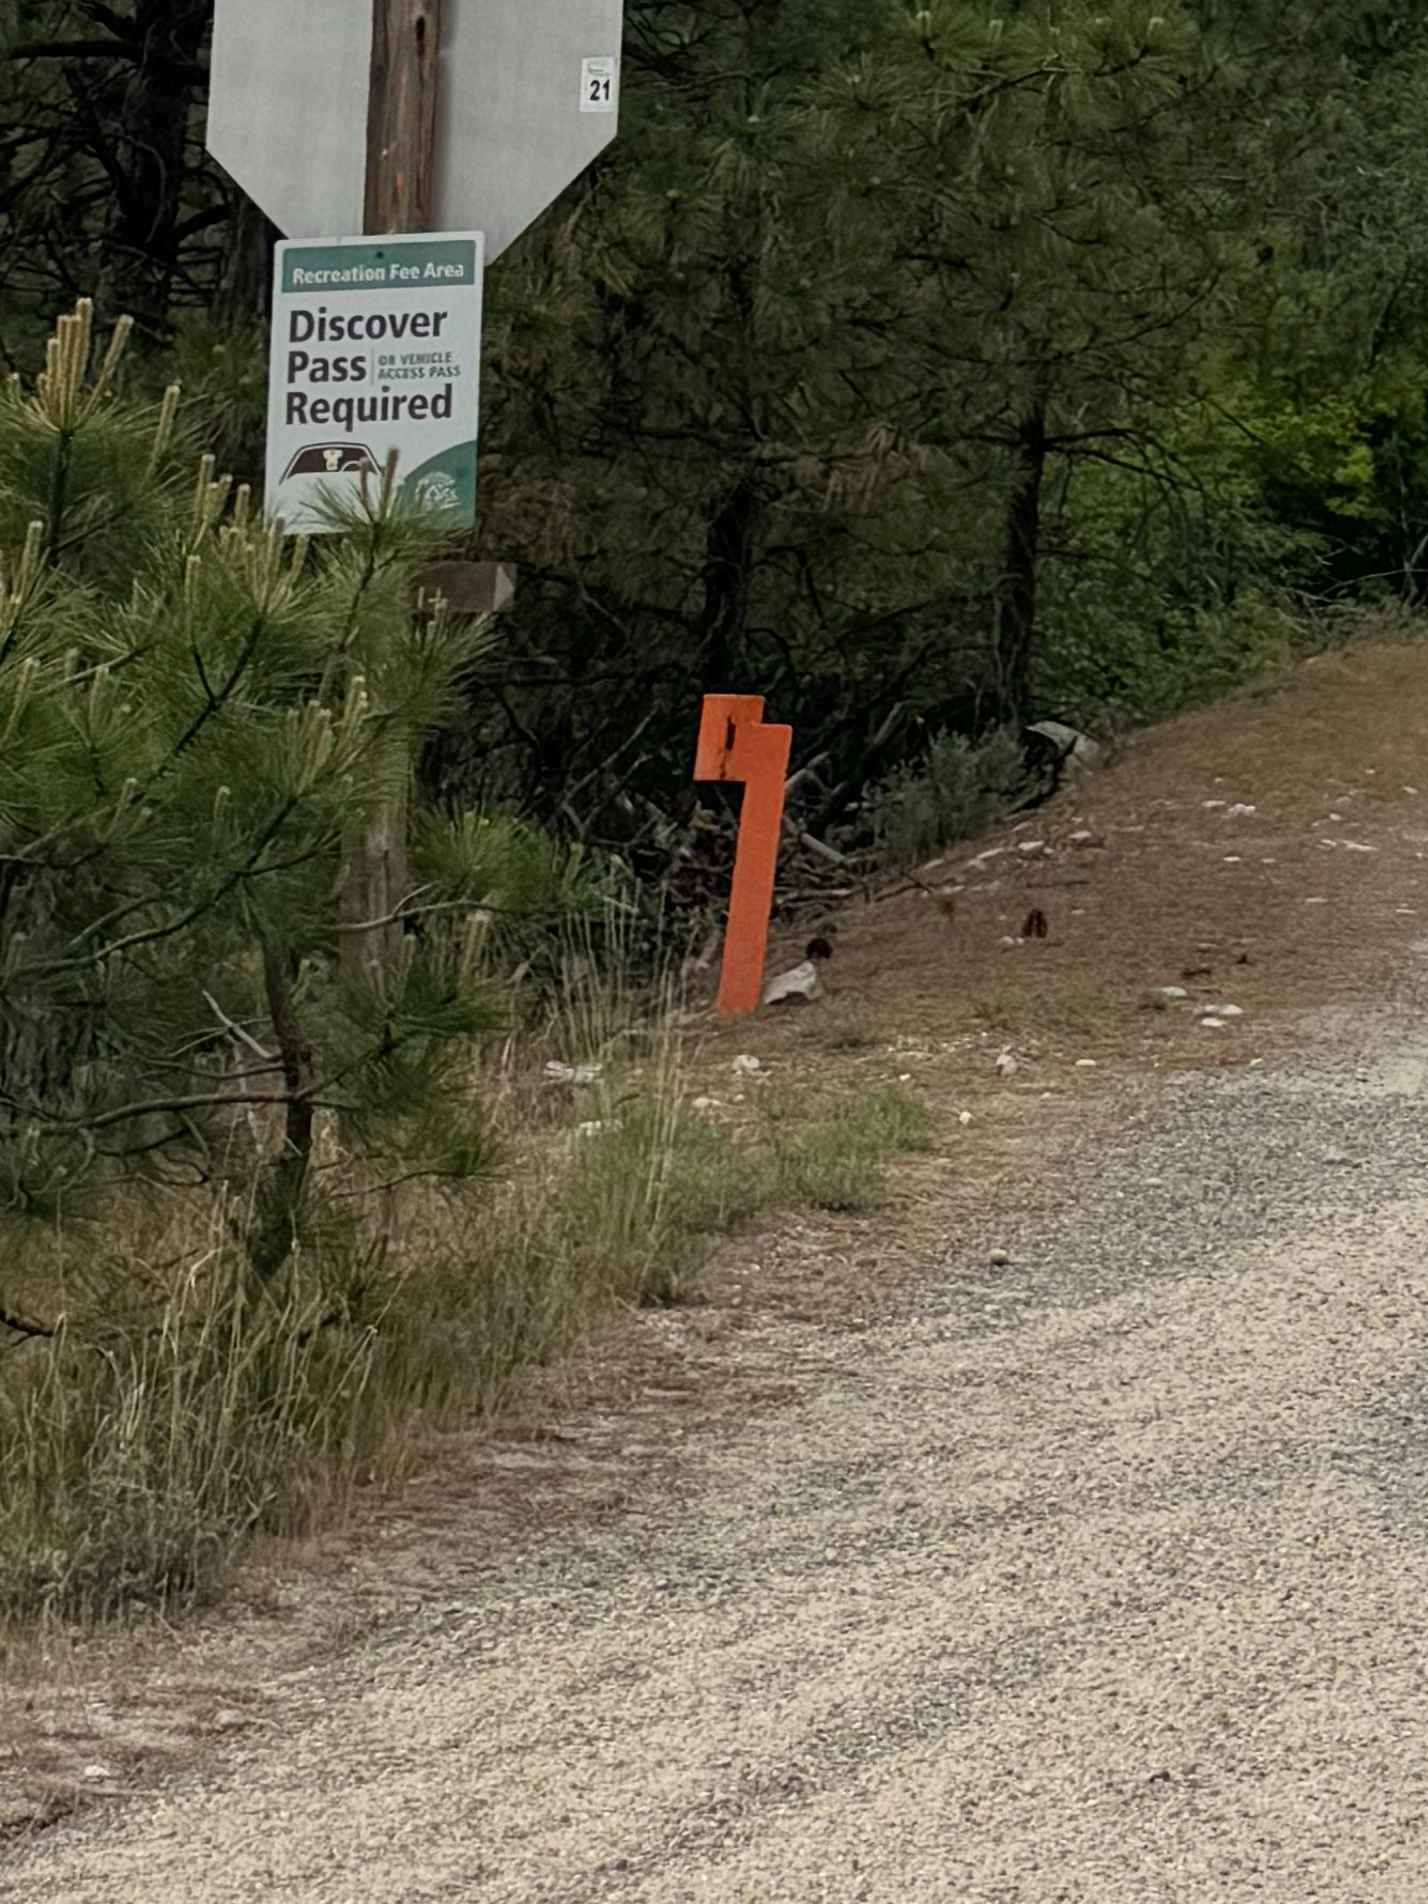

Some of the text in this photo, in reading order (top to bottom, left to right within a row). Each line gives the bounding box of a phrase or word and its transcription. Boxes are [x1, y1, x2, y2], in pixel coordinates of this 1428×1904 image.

[590, 79, 610, 101] 21
[293, 261, 464, 285] Recreation Fee Area
[289, 306, 448, 343] Discover
[287, 350, 367, 384] Pass
[378, 365, 461, 380] ACCESS PASS
[285, 382, 453, 433] Required
